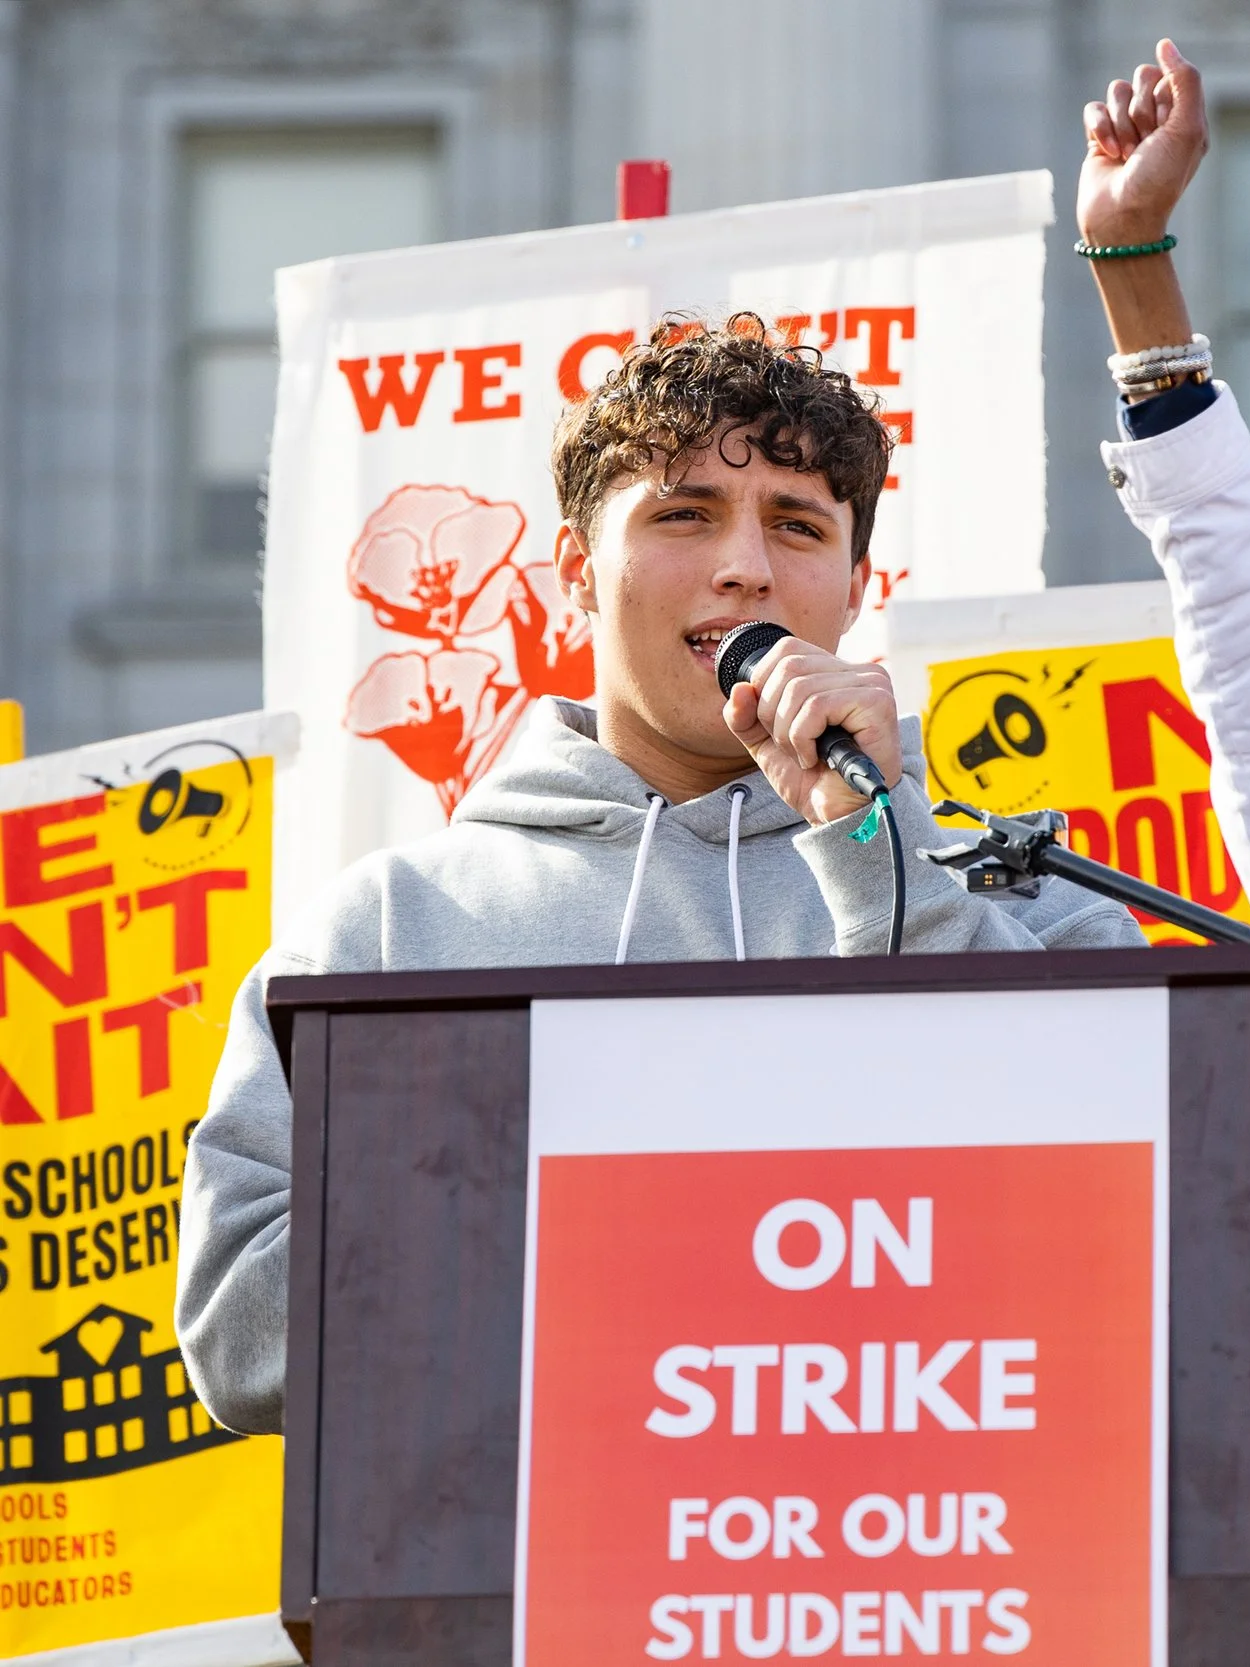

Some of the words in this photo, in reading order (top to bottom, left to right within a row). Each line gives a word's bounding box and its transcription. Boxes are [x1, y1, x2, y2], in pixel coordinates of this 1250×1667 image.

[339, 343, 521, 433] WE
[557, 306, 915, 405] C'T
[30, 1198, 181, 1291] DESER
[751, 1197, 933, 1291] ON
[645, 1338, 1037, 1438] STRIKE
[668, 1495, 824, 1560] FOR
[842, 1492, 1014, 1558] OUR
[644, 1587, 1032, 1660] STUDENTS
